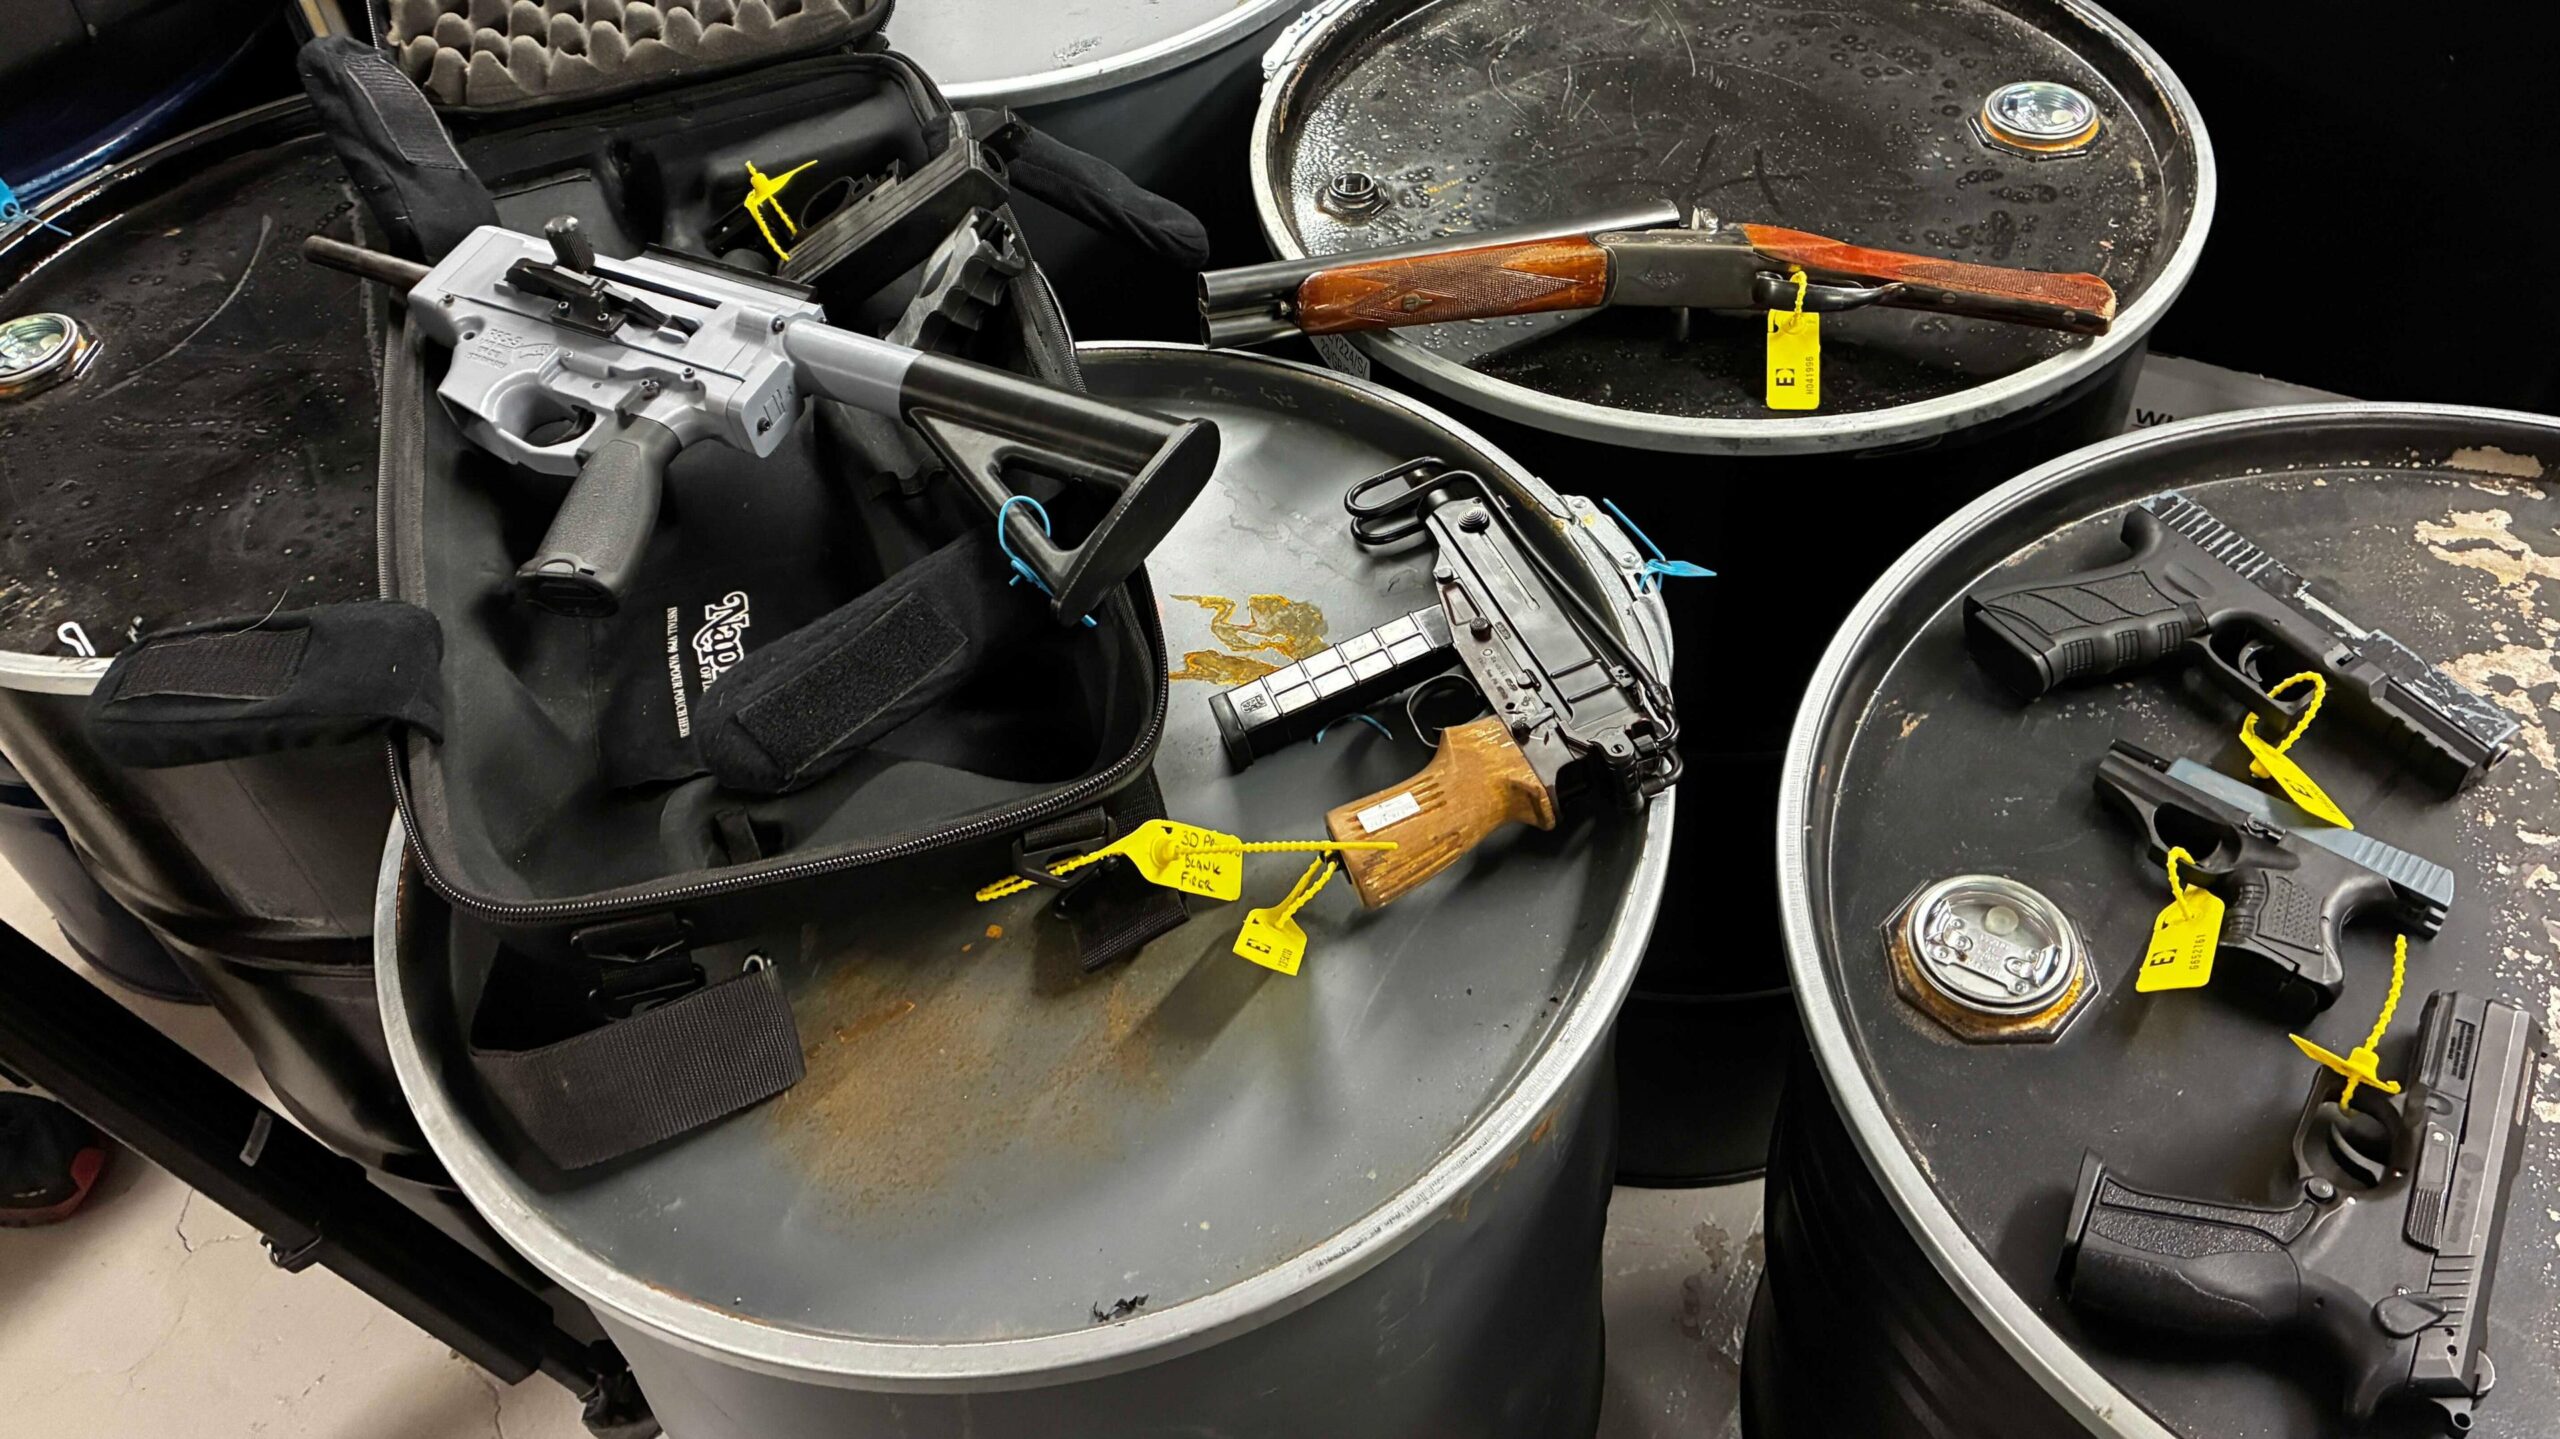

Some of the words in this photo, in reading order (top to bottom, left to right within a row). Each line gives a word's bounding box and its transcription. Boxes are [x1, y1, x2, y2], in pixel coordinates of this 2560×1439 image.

[667, 606, 678, 636] INSTALL
[668, 653, 683, 689] VAPOUR
[673, 688, 688, 718] POUCH
